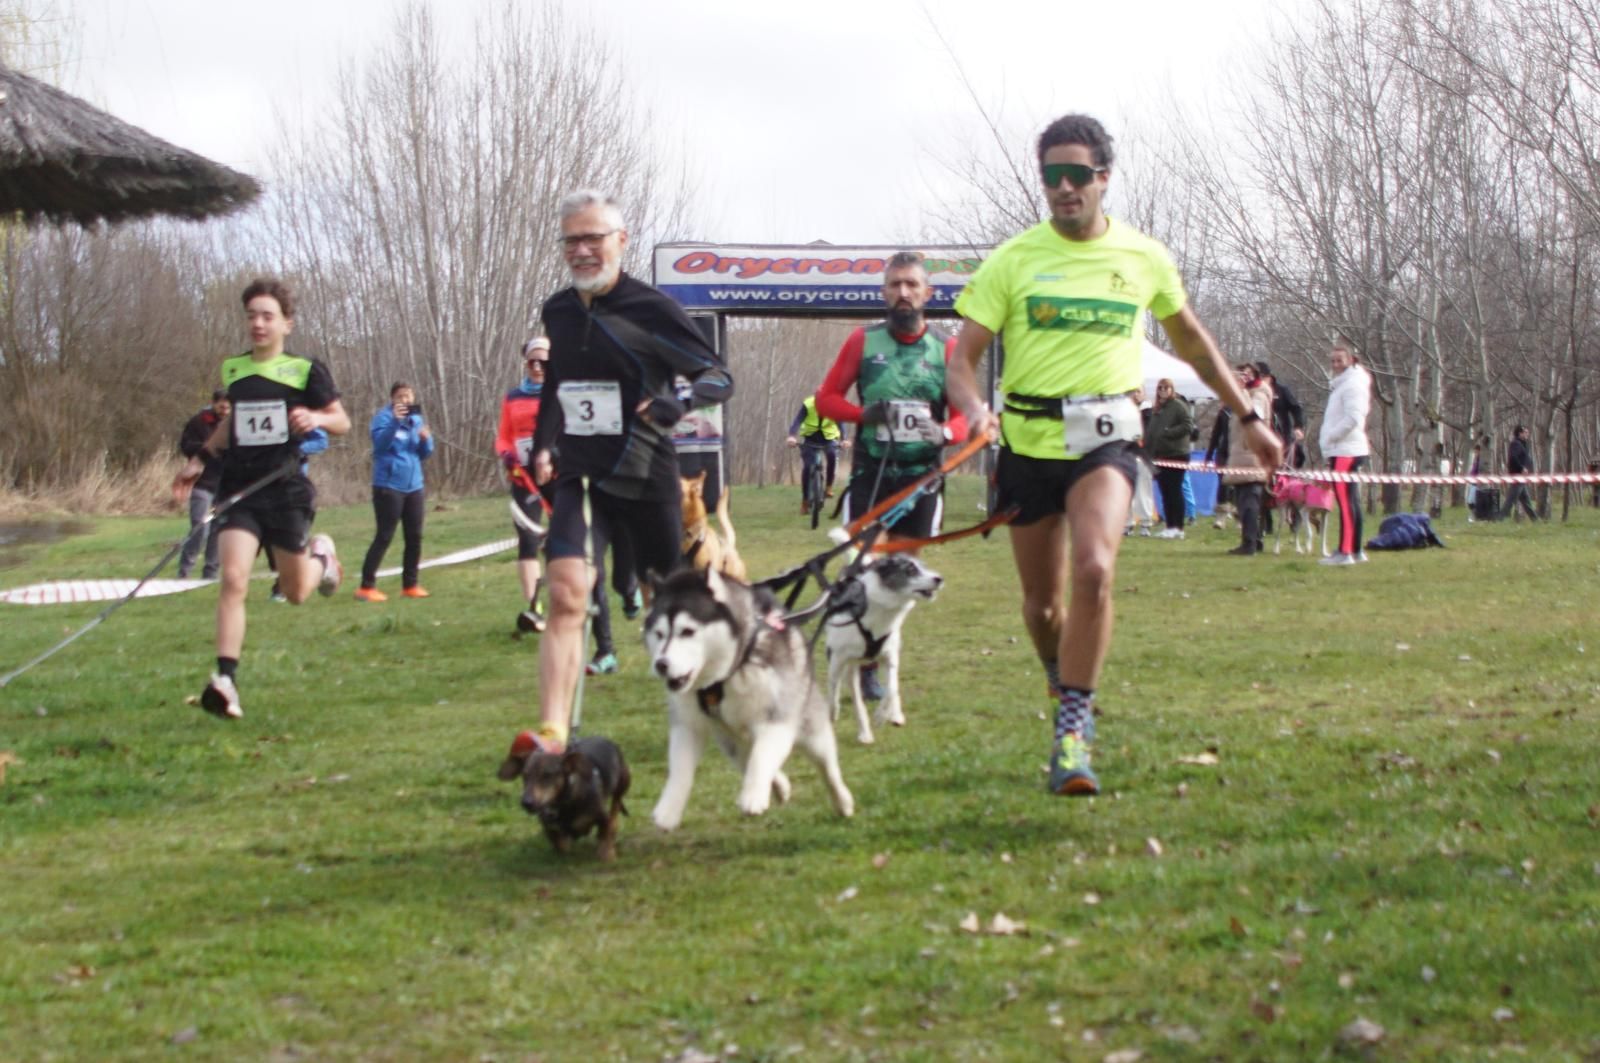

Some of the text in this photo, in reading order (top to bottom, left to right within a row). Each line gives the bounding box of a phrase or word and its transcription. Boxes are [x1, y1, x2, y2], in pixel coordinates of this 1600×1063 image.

[580, 400, 594, 421] 3
[247, 416, 273, 433] 14
[1096, 414, 1114, 437] 6
